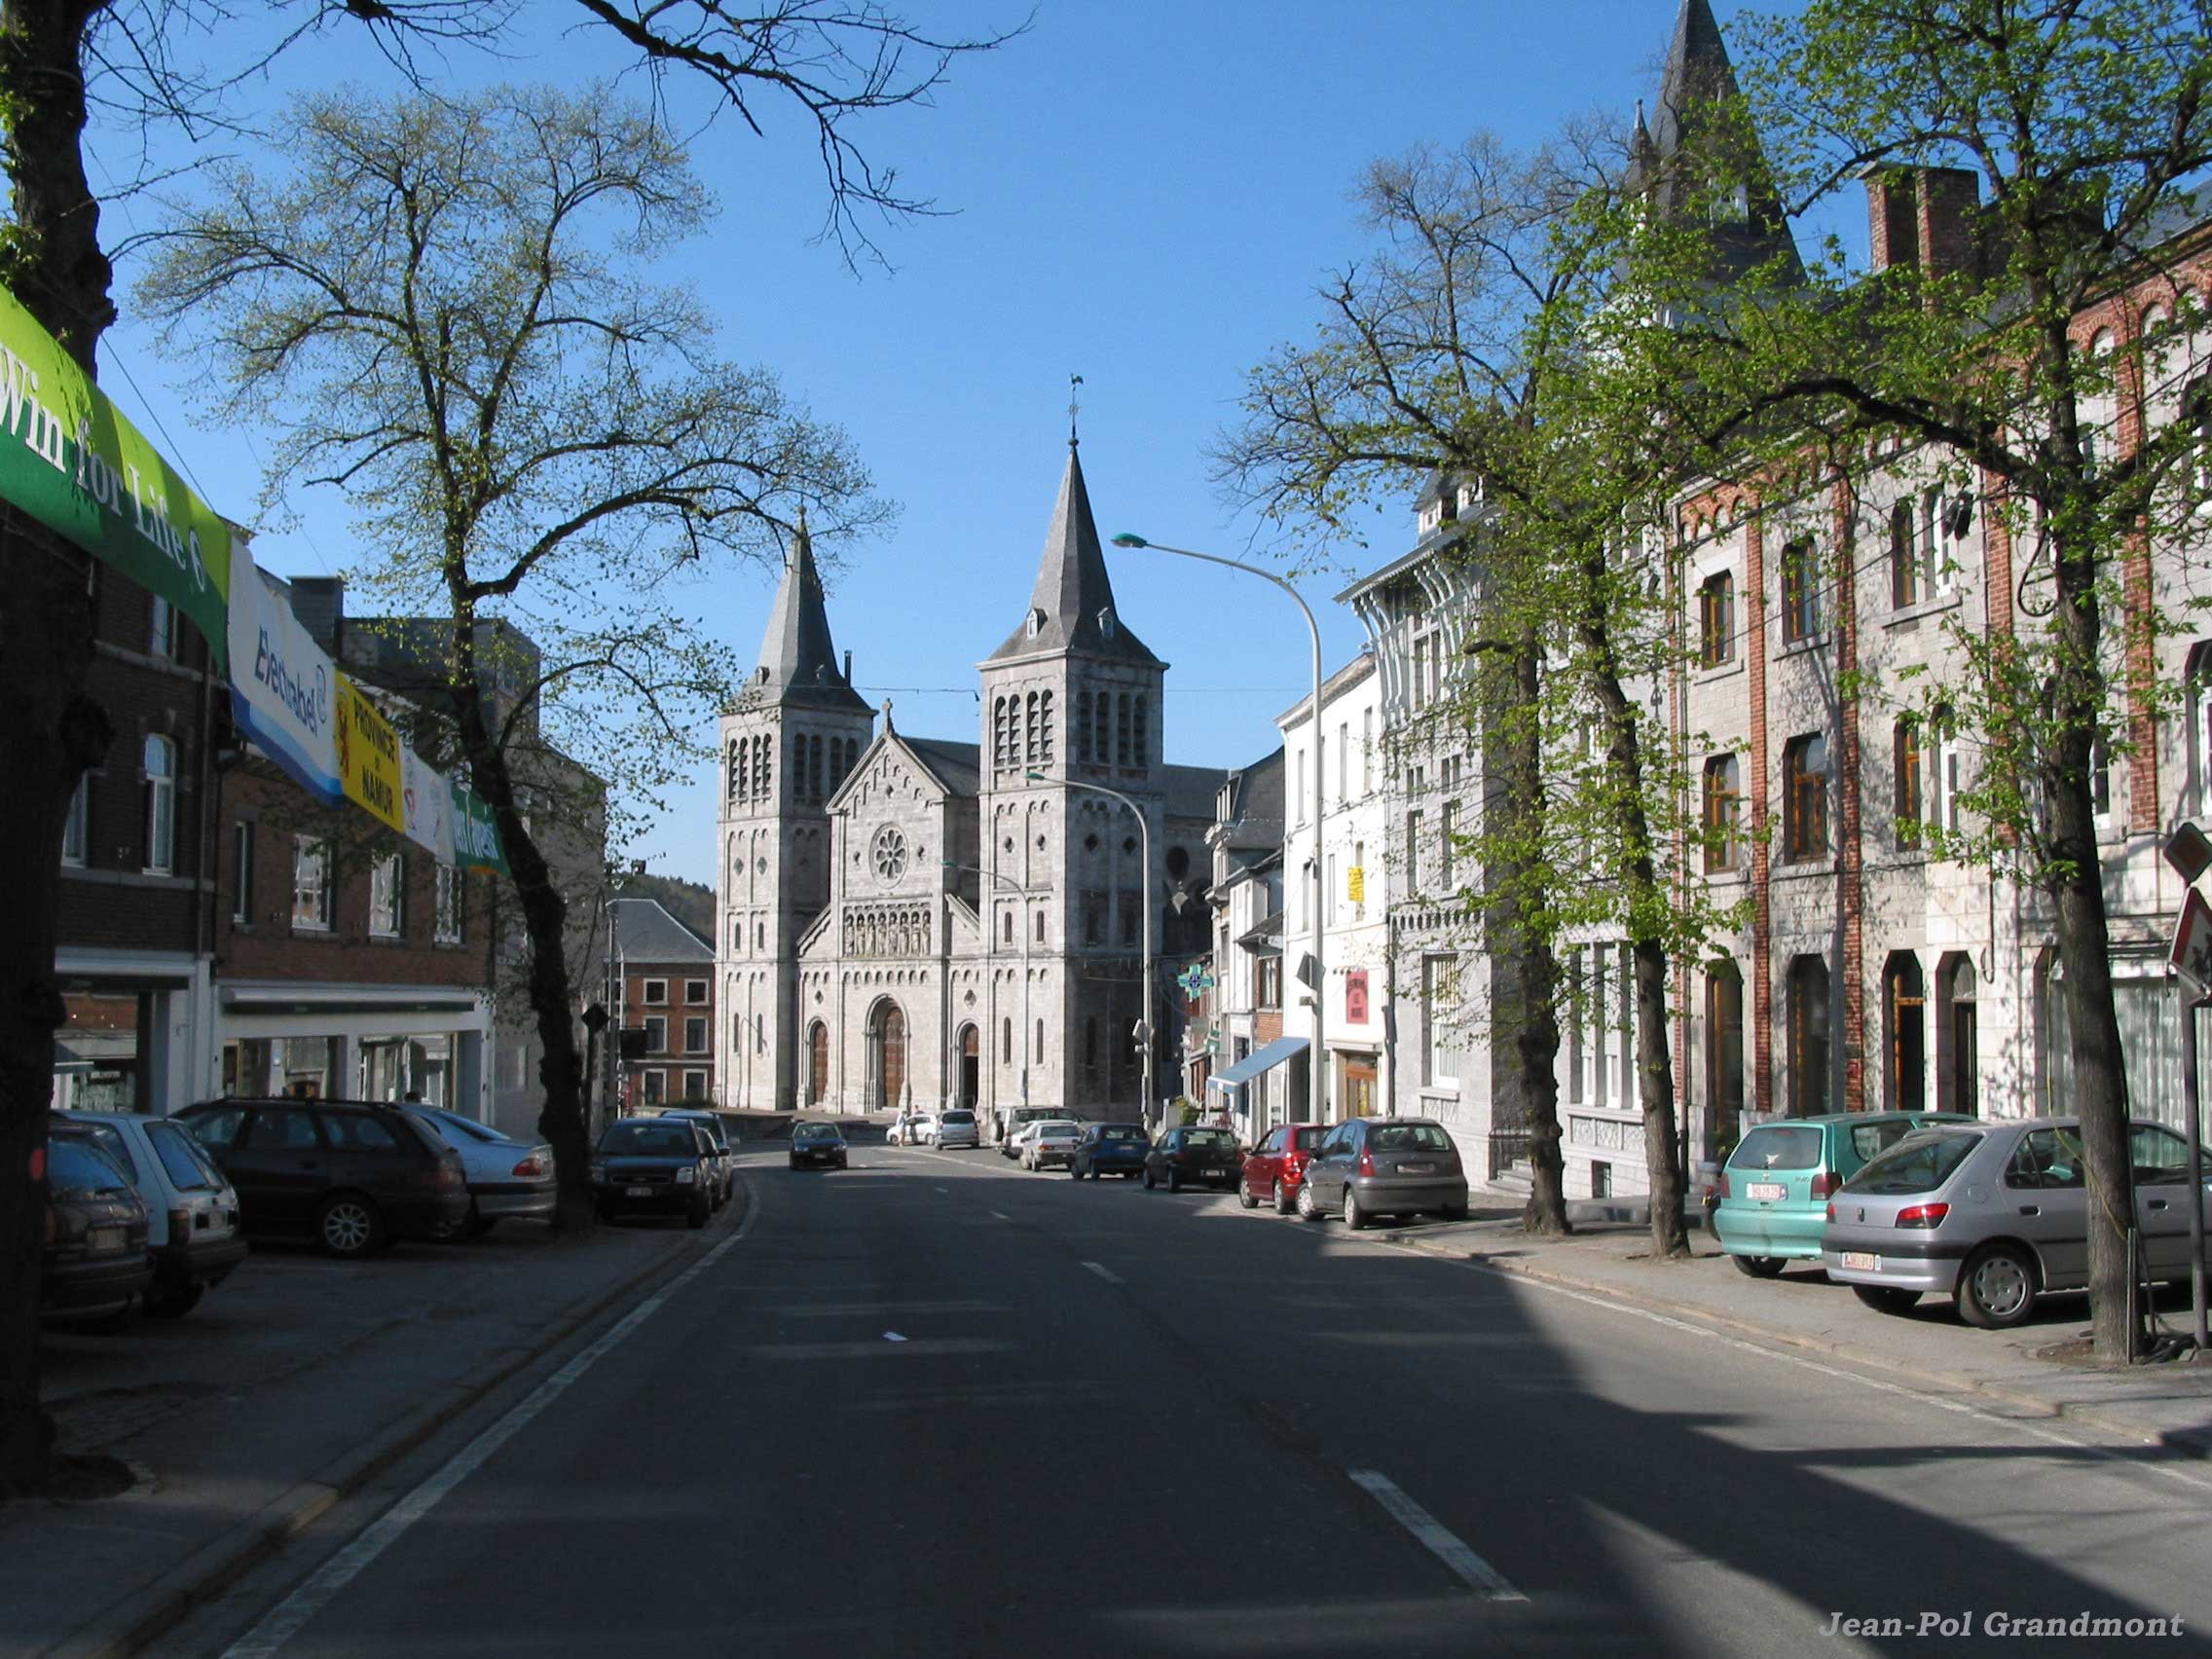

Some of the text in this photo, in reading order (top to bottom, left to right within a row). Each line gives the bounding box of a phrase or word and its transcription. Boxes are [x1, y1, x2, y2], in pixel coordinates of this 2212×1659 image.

[0, 345, 186, 571] Win for Life
[255, 625, 317, 737] Electrabel
[353, 695, 395, 763] PROVINCE
[361, 764, 394, 819] NAMUR
